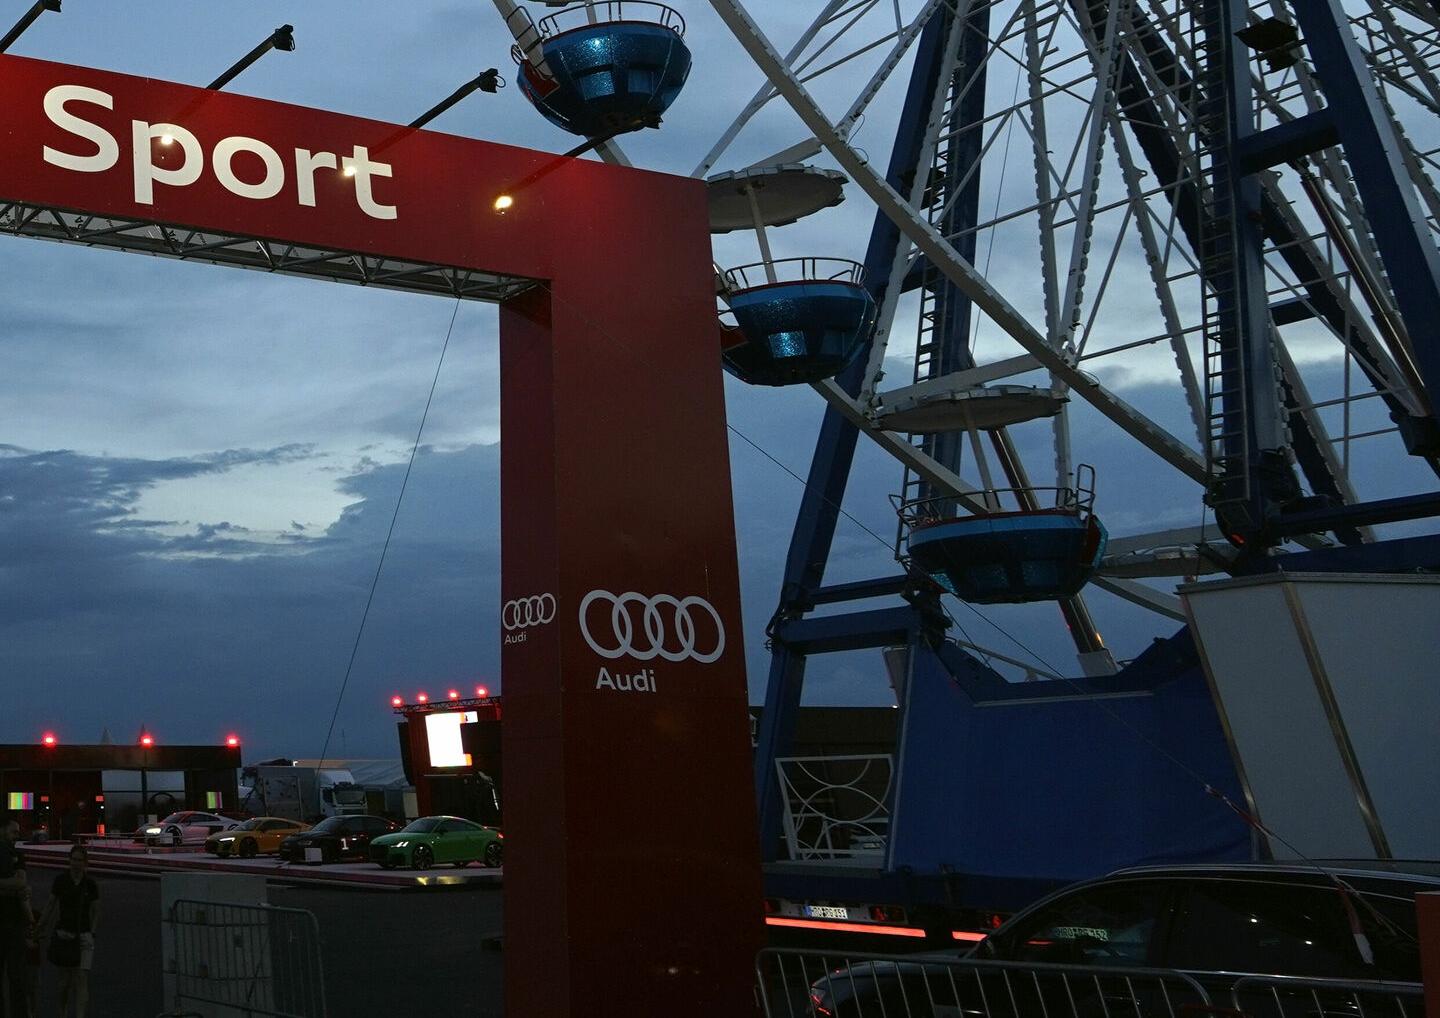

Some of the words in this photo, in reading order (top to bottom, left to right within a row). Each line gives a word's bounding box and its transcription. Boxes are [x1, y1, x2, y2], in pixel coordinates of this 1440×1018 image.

[42, 84, 399, 221] Sport
[504, 631, 527, 645] Audi
[595, 666, 657, 693] Audi
